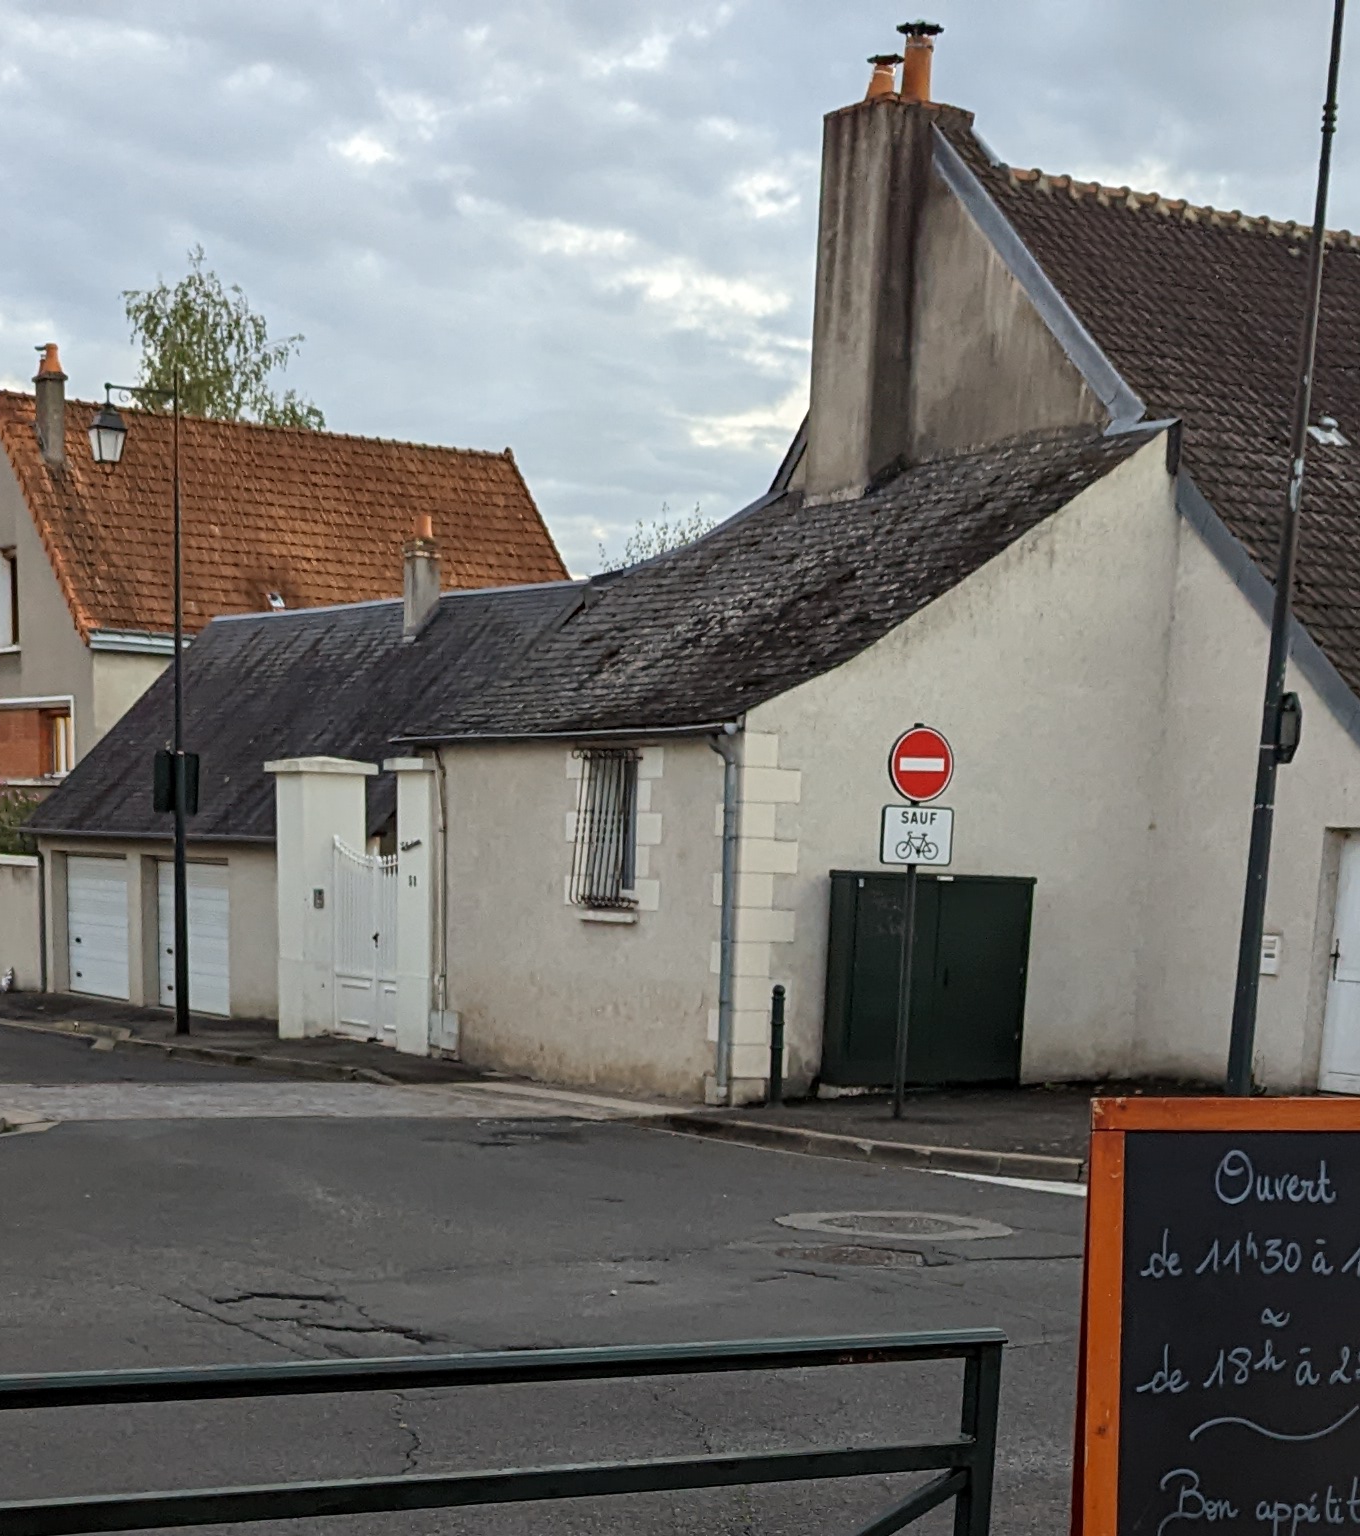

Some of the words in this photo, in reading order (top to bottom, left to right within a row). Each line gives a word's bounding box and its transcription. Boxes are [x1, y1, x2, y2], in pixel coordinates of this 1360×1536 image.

[900, 811, 938, 825] SAUF
[1215, 1149, 1337, 1205] Ouvert
[1140, 1228, 1183, 1279] de
[1195, 1231, 1302, 1275] 11h30
[1311, 1238, 1334, 1276] à
[1136, 1343, 1189, 1394] de
[1203, 1339, 1287, 1388] 18h
[1295, 1346, 1321, 1387] à
